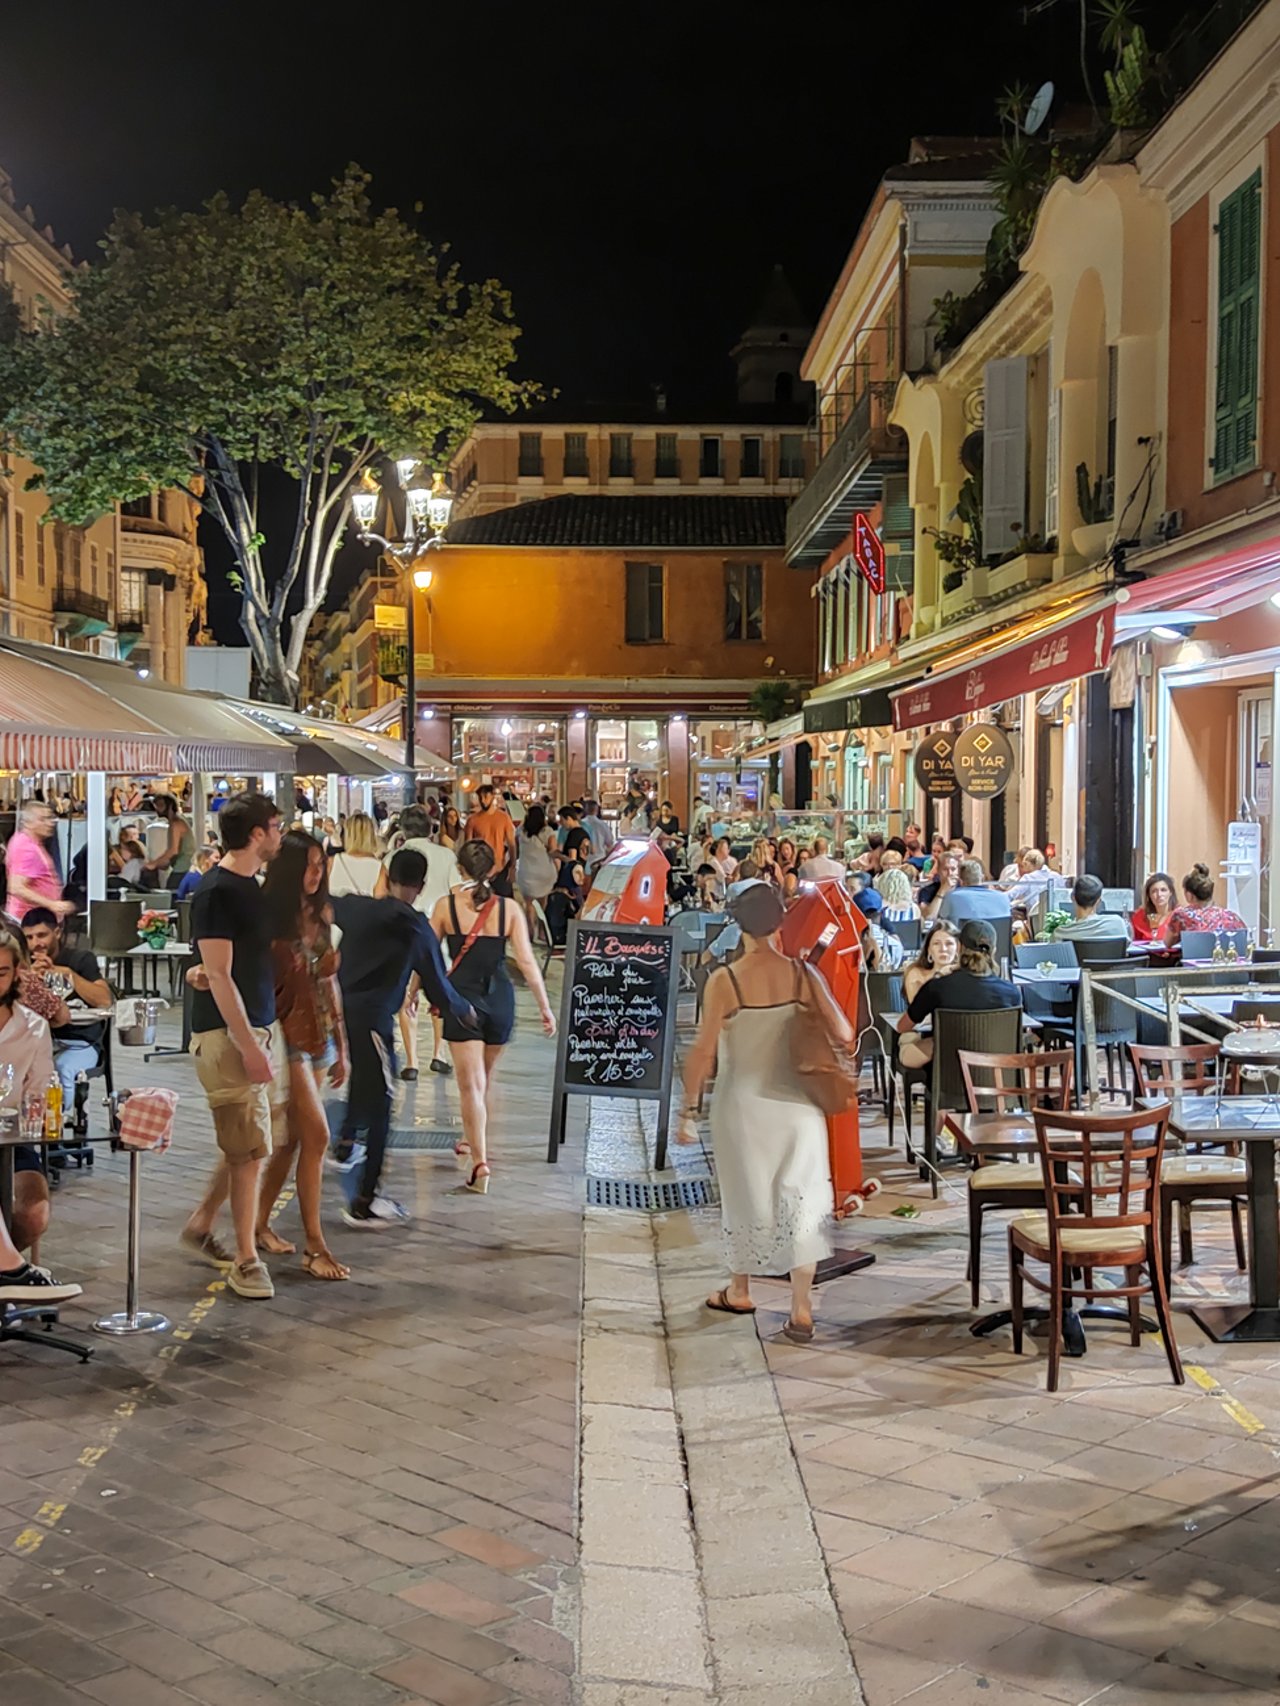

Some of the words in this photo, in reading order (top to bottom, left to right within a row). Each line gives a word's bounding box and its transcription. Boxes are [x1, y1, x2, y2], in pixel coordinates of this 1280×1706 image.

[858, 527, 879, 579] TABAC
[923, 760, 934, 770] DI
[939, 760, 954, 770] YA
[961, 756, 974, 767] DI
[979, 756, 1005, 768] YAR
[622, 964, 638, 976] du
